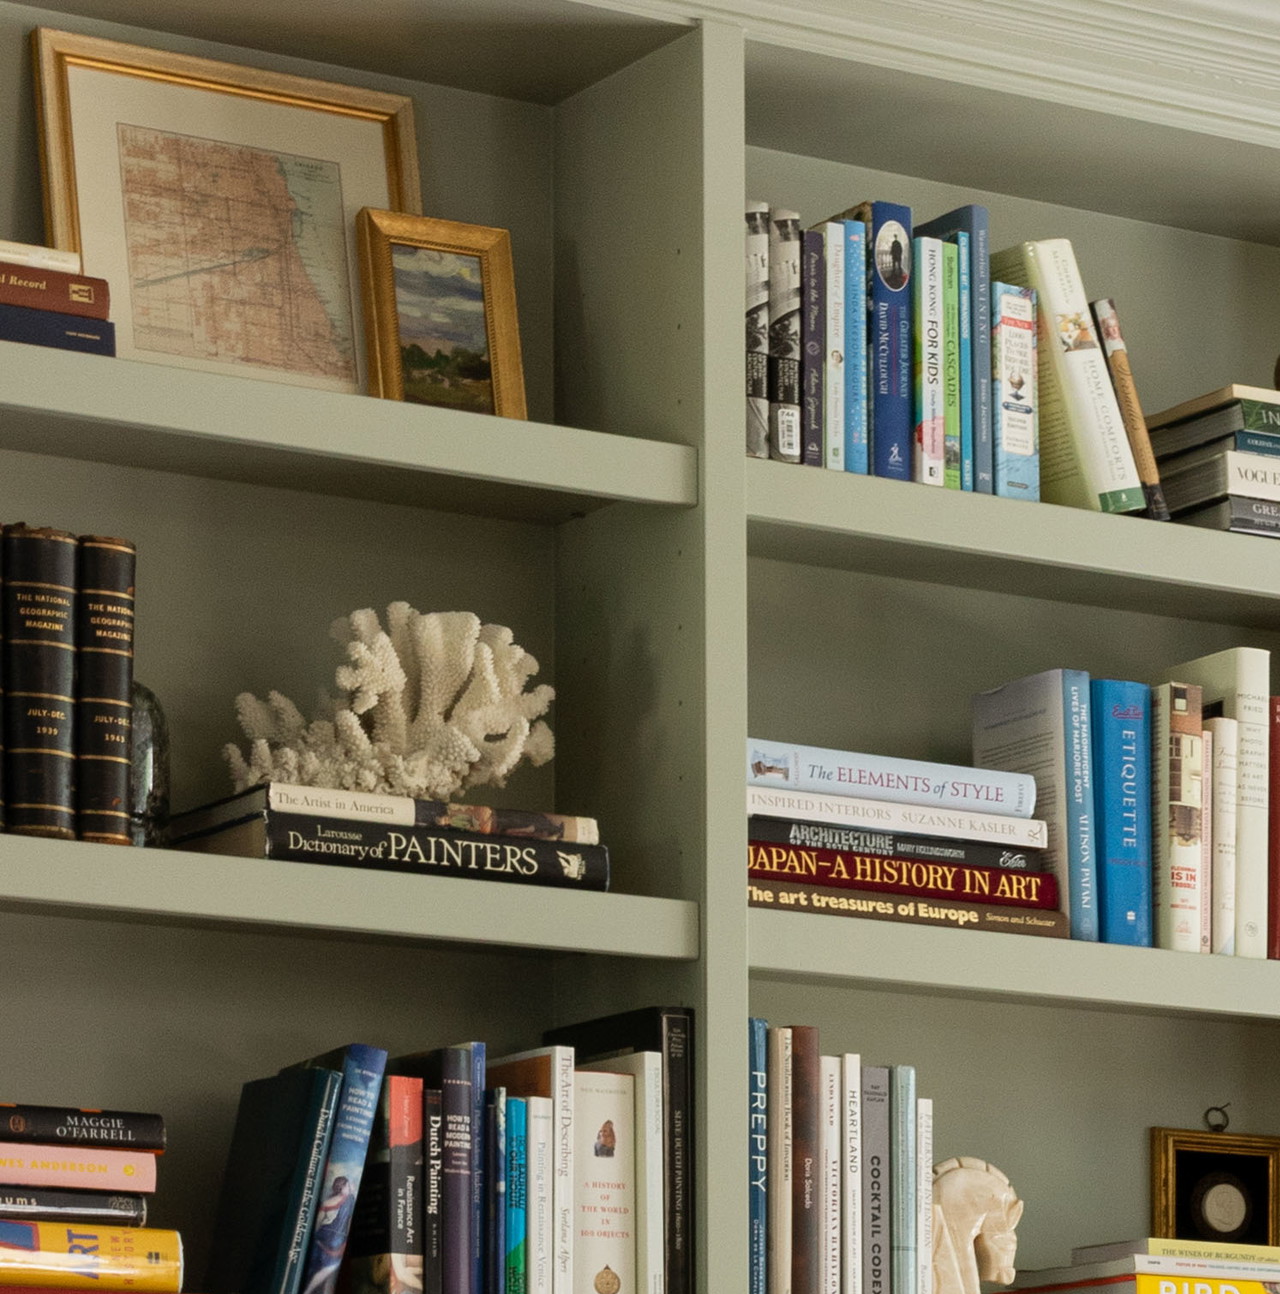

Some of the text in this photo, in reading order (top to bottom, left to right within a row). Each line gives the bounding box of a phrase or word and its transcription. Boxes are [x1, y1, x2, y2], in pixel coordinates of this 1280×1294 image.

[9, 275, 47, 290] Record
[927, 248, 939, 385] HONG KONG FOR KIDS
[16, 593, 71, 607] THE NATIONAL
[19, 607, 69, 619] GEOGRAPHIC
[25, 620, 64, 631] MAGAZINE
[275, 791, 394, 815] The Artist in America
[807, 763, 1005, 804] The ELEMENTS of STYLE
[1121, 729, 1137, 848] ETIQUETTE
[316, 824, 363, 841] Larousse
[751, 793, 1017, 837] INSPIRED INTERIORS SUZANNE KASLER
[287, 830, 539, 875] Dictionary of PAINTERS
[789, 823, 894, 851] ARCHITECTURE
[854, 856, 954, 892] HISTORY
[963, 870, 991, 897] IN
[996, 874, 1041, 902] ART
[778, 888, 807, 904] art
[812, 894, 895, 914] treasures
[897, 898, 917, 917] of
[918, 902, 980, 926] Europe
[56, 1126, 136, 1141] O'FARRELL
[66, 1115, 125, 1129] MAGGIE
[751, 1071, 767, 1192] PREPPY
[848, 1090, 858, 1174] HEARTLAND
[427, 1115, 442, 1215] Dutch Painting
[870, 1155, 882, 1240] COCKTAIL
